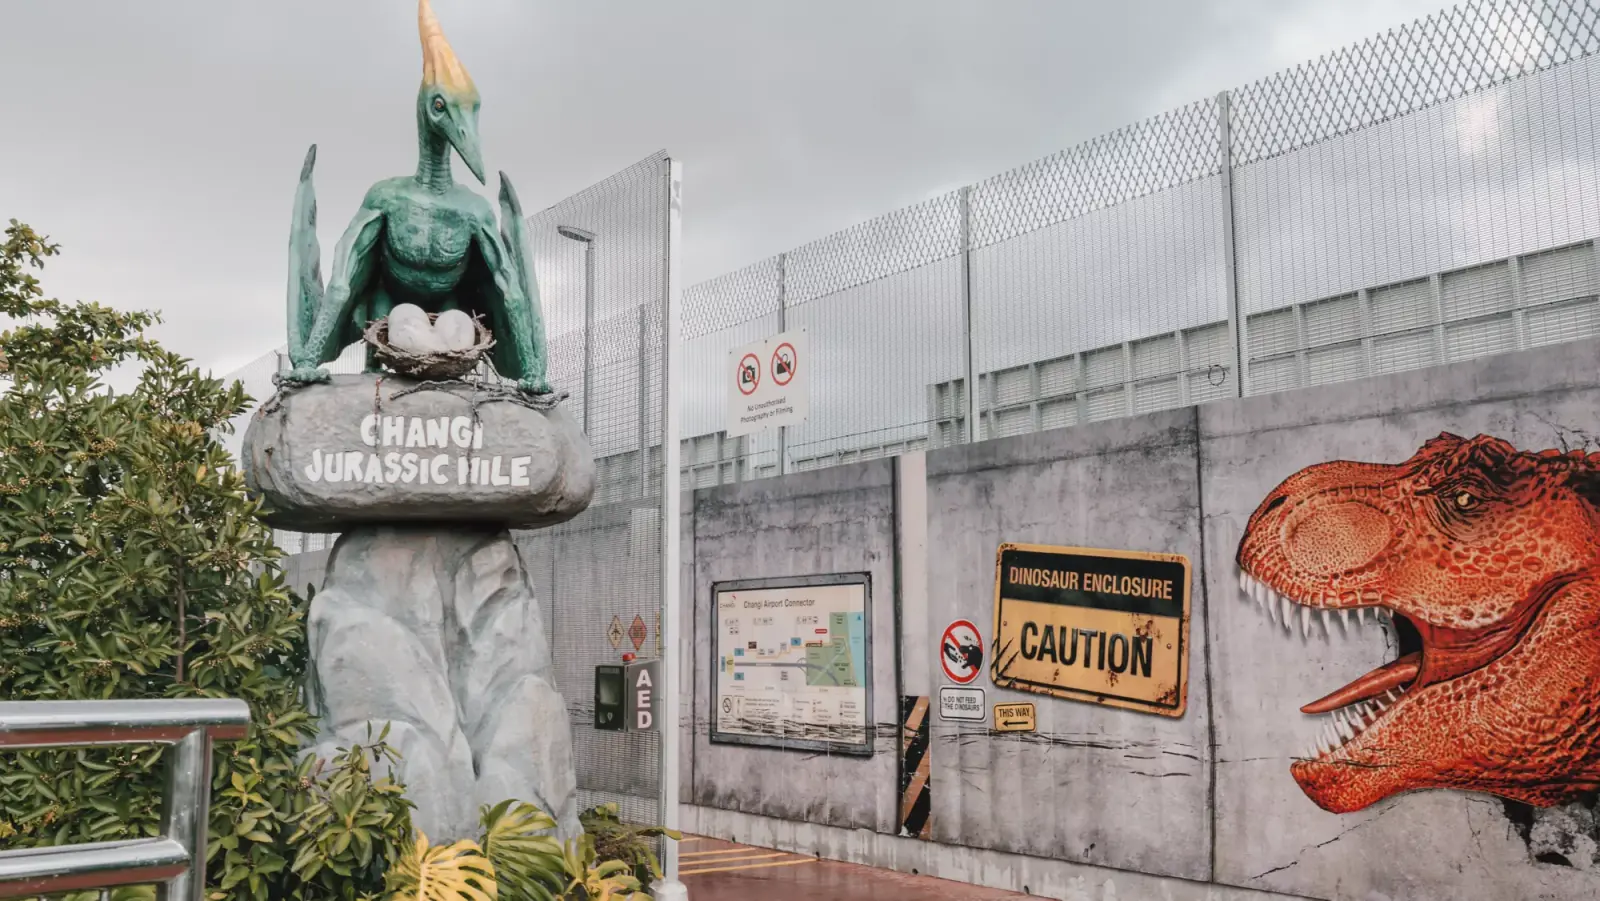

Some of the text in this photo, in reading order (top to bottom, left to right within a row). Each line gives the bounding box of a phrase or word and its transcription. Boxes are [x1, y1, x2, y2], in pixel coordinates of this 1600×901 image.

[776, 406, 793, 415] Filming
[360, 414, 483, 449] CHANGI
[305, 449, 449, 485] JURASSIC
[1009, 566, 1173, 600] DINOSAUR ENCLOSURE
[743, 598, 815, 610] Changi Airport Connector
[1020, 621, 1153, 678] CAUTION
[635, 668, 653, 730] AED
[955, 703, 980, 711] DINOSAURS
[998, 708, 1030, 718] THIS WAY
